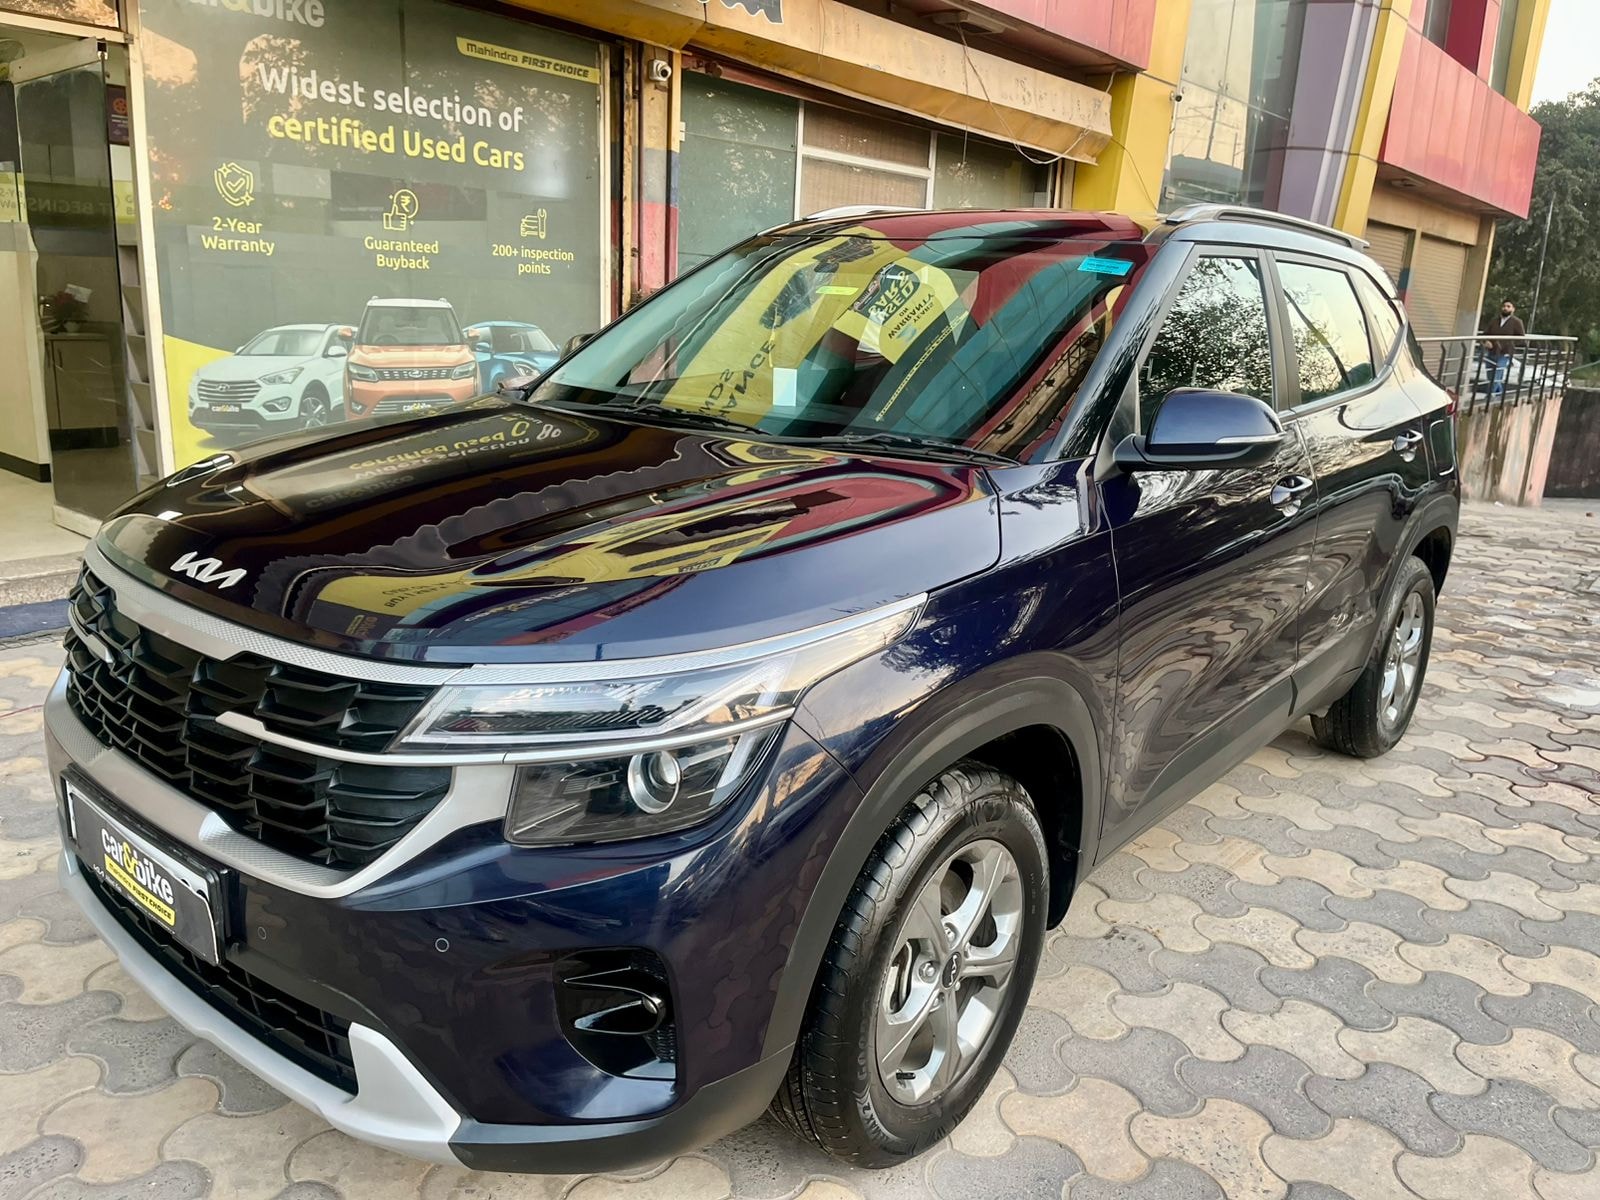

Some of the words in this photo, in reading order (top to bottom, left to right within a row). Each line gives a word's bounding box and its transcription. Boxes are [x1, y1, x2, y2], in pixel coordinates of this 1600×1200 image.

[466, 42, 518, 63] Mahindra
[521, 55, 551, 69] FIRST
[553, 62, 589, 78] CHOICE
[258, 62, 366, 108] Widest
[373, 86, 492, 128] selection
[498, 107, 524, 132] of
[268, 115, 395, 154] certified
[403, 129, 466, 163] Used
[473, 141, 525, 171] Cars
[212, 216, 263, 234] 2-Year
[201, 234, 275, 256] Warranty
[364, 236, 439, 254] Guaranteed
[492, 244, 519, 257] 200+
[521, 245, 574, 261] inspection
[376, 254, 430, 271] Buyback
[518, 261, 551, 275] points
